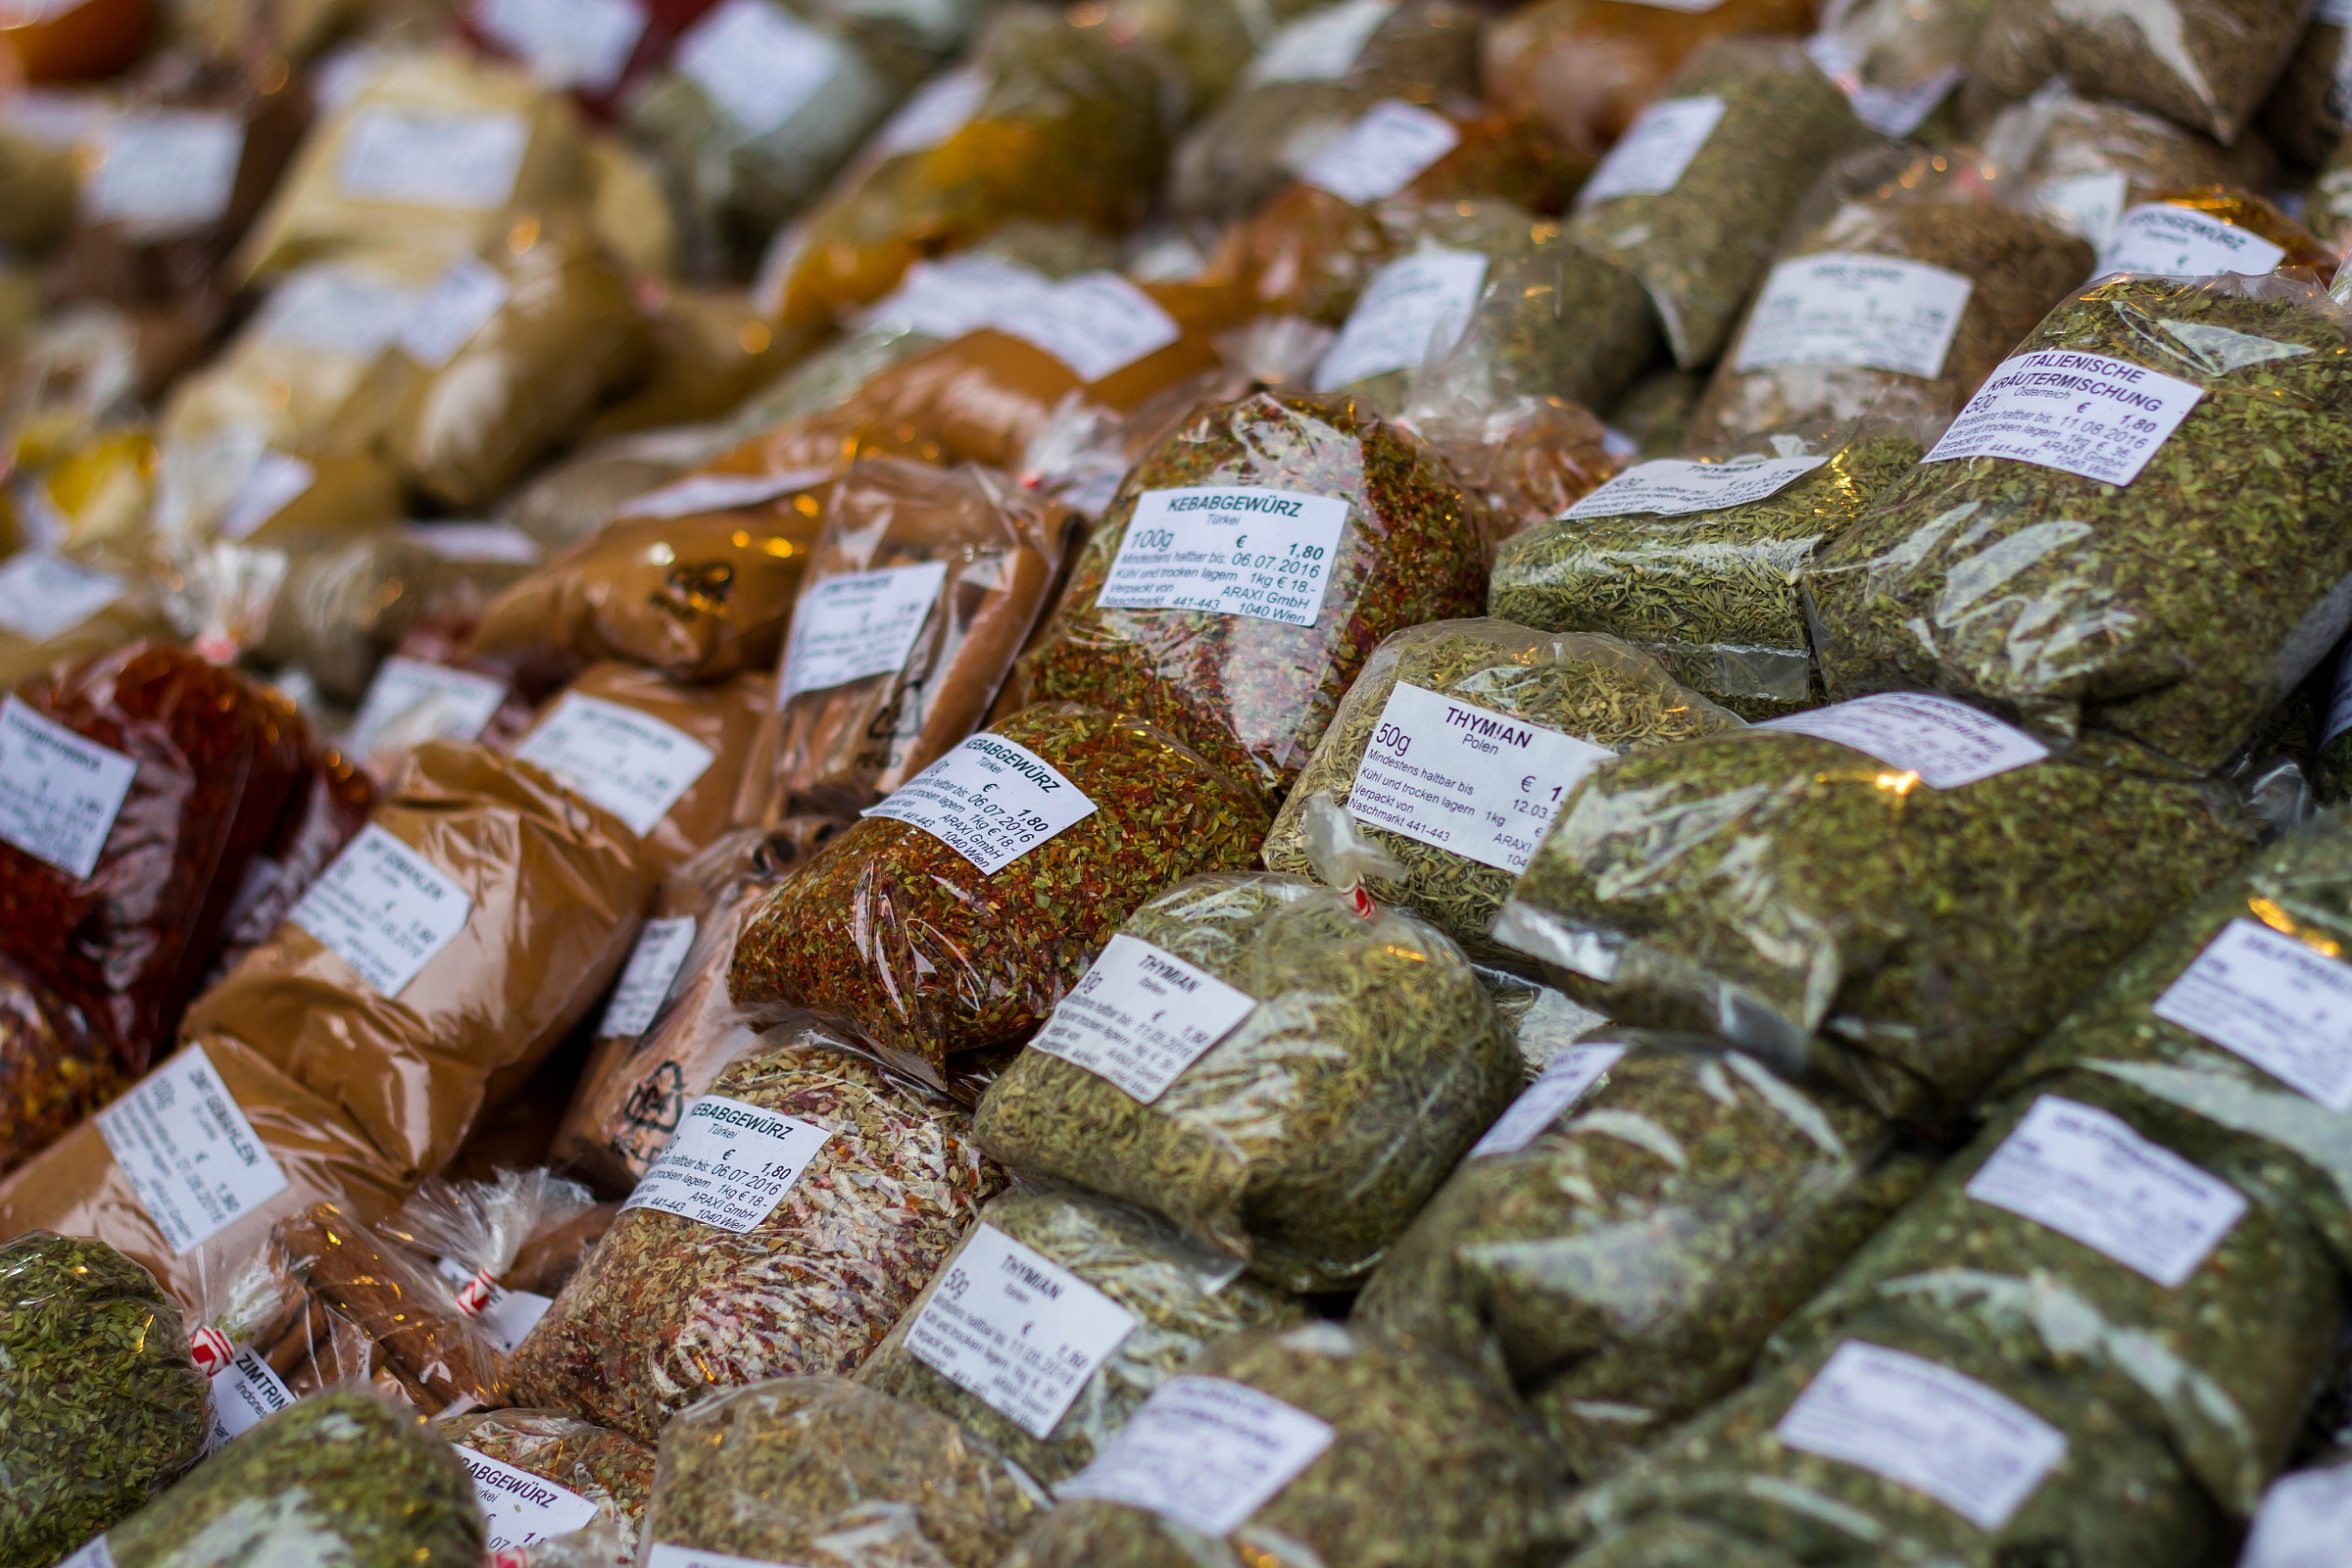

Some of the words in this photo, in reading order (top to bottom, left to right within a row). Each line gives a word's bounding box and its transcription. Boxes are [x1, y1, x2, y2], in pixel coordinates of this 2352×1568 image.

[2020, 354, 2146, 384] ITALIENISCHE
[1985, 372, 2163, 412] KRÄUTERMISCHUNG
[2013, 386, 2071, 401] Österreich
[1966, 394, 1998, 414] 50g
[2077, 402, 2091, 414] €
[2121, 414, 2156, 433] 1,80
[2059, 416, 2148, 450] 11.08.2016
[2083, 450, 2129, 468] GmbH
[1166, 495, 1303, 517] KEBABGEWÜRZ
[1206, 514, 1242, 526] Türkei
[1131, 529, 1174, 551] 100g
[1236, 535, 1248, 548] €
[1288, 543, 1324, 561] 1,80
[1120, 552, 1171, 564] Mindestens
[1173, 551, 1207, 564] haltbar
[1232, 552, 1321, 578] 06.07.2016
[1139, 567, 1157, 579] und
[1159, 567, 1200, 579] trocken
[1200, 567, 1238, 582] lagern
[1250, 572, 1274, 588] 1kg
[1277, 577, 1288, 589] €
[1102, 596, 1163, 607] Naschmarkt
[1173, 598, 1220, 610] 441-443
[1239, 603, 1270, 617] 1040
[1273, 609, 1305, 623] Wien
[1109, 582, 1153, 596] Verpackt
[1155, 583, 1174, 593] von
[1220, 586, 1263, 602] ARAXI
[1267, 591, 1309, 610] GmbH
[1445, 707, 1534, 749] THYMIAN
[1376, 723, 1411, 757] 50g
[1521, 775, 1537, 794] €
[1462, 735, 1499, 755] Polen
[975, 756, 1007, 774] Türkei
[1367, 749, 1419, 776] Mindestens
[1421, 765, 1456, 789] haltbar
[1458, 779, 1474, 796] bis
[1354, 783, 1396, 810] Verpackt
[1396, 800, 1415, 813] von
[1492, 833, 1533, 853] ARAXI
[1360, 766, 1382, 784] Kühl
[1383, 776, 1401, 792] und
[1401, 784, 1441, 804] trocken
[1442, 796, 1476, 816] lagern
[1486, 811, 1507, 827] 1kg
[1535, 827, 1544, 838] €
[967, 794, 1035, 843] 06.07.2016
[969, 814, 990, 830] 1kg
[1018, 809, 1049, 832] 1,80
[1348, 798, 1405, 828] Naschmarkt
[1406, 819, 1450, 843] 441-443
[903, 811, 936, 828] 441-443
[942, 831, 968, 849] 1040
[963, 846, 990, 868] Wien
[939, 813, 974, 835] ARAXI
[969, 834, 1004, 859] GmbH
[1138, 955, 1202, 995] THYMIAN
[708, 1123, 740, 1140] Türkei
[710, 1163, 782, 1196] 06.07.2016
[723, 1150, 736, 1160] €
[760, 1161, 792, 1181] 1,80
[688, 1192, 725, 1209] ARAXI
[723, 1204, 759, 1220] GmbH
[717, 1183, 739, 1200] 1kg
[738, 1191, 750, 1201] €
[651, 1197, 686, 1212] 441-443
[695, 1208, 722, 1223] 1040
[720, 1215, 747, 1231] Wien
[944, 1266, 971, 1300] 50g
[1000, 1253, 1065, 1301] THYMIAN
[234, 1379, 268, 1419] Indones
